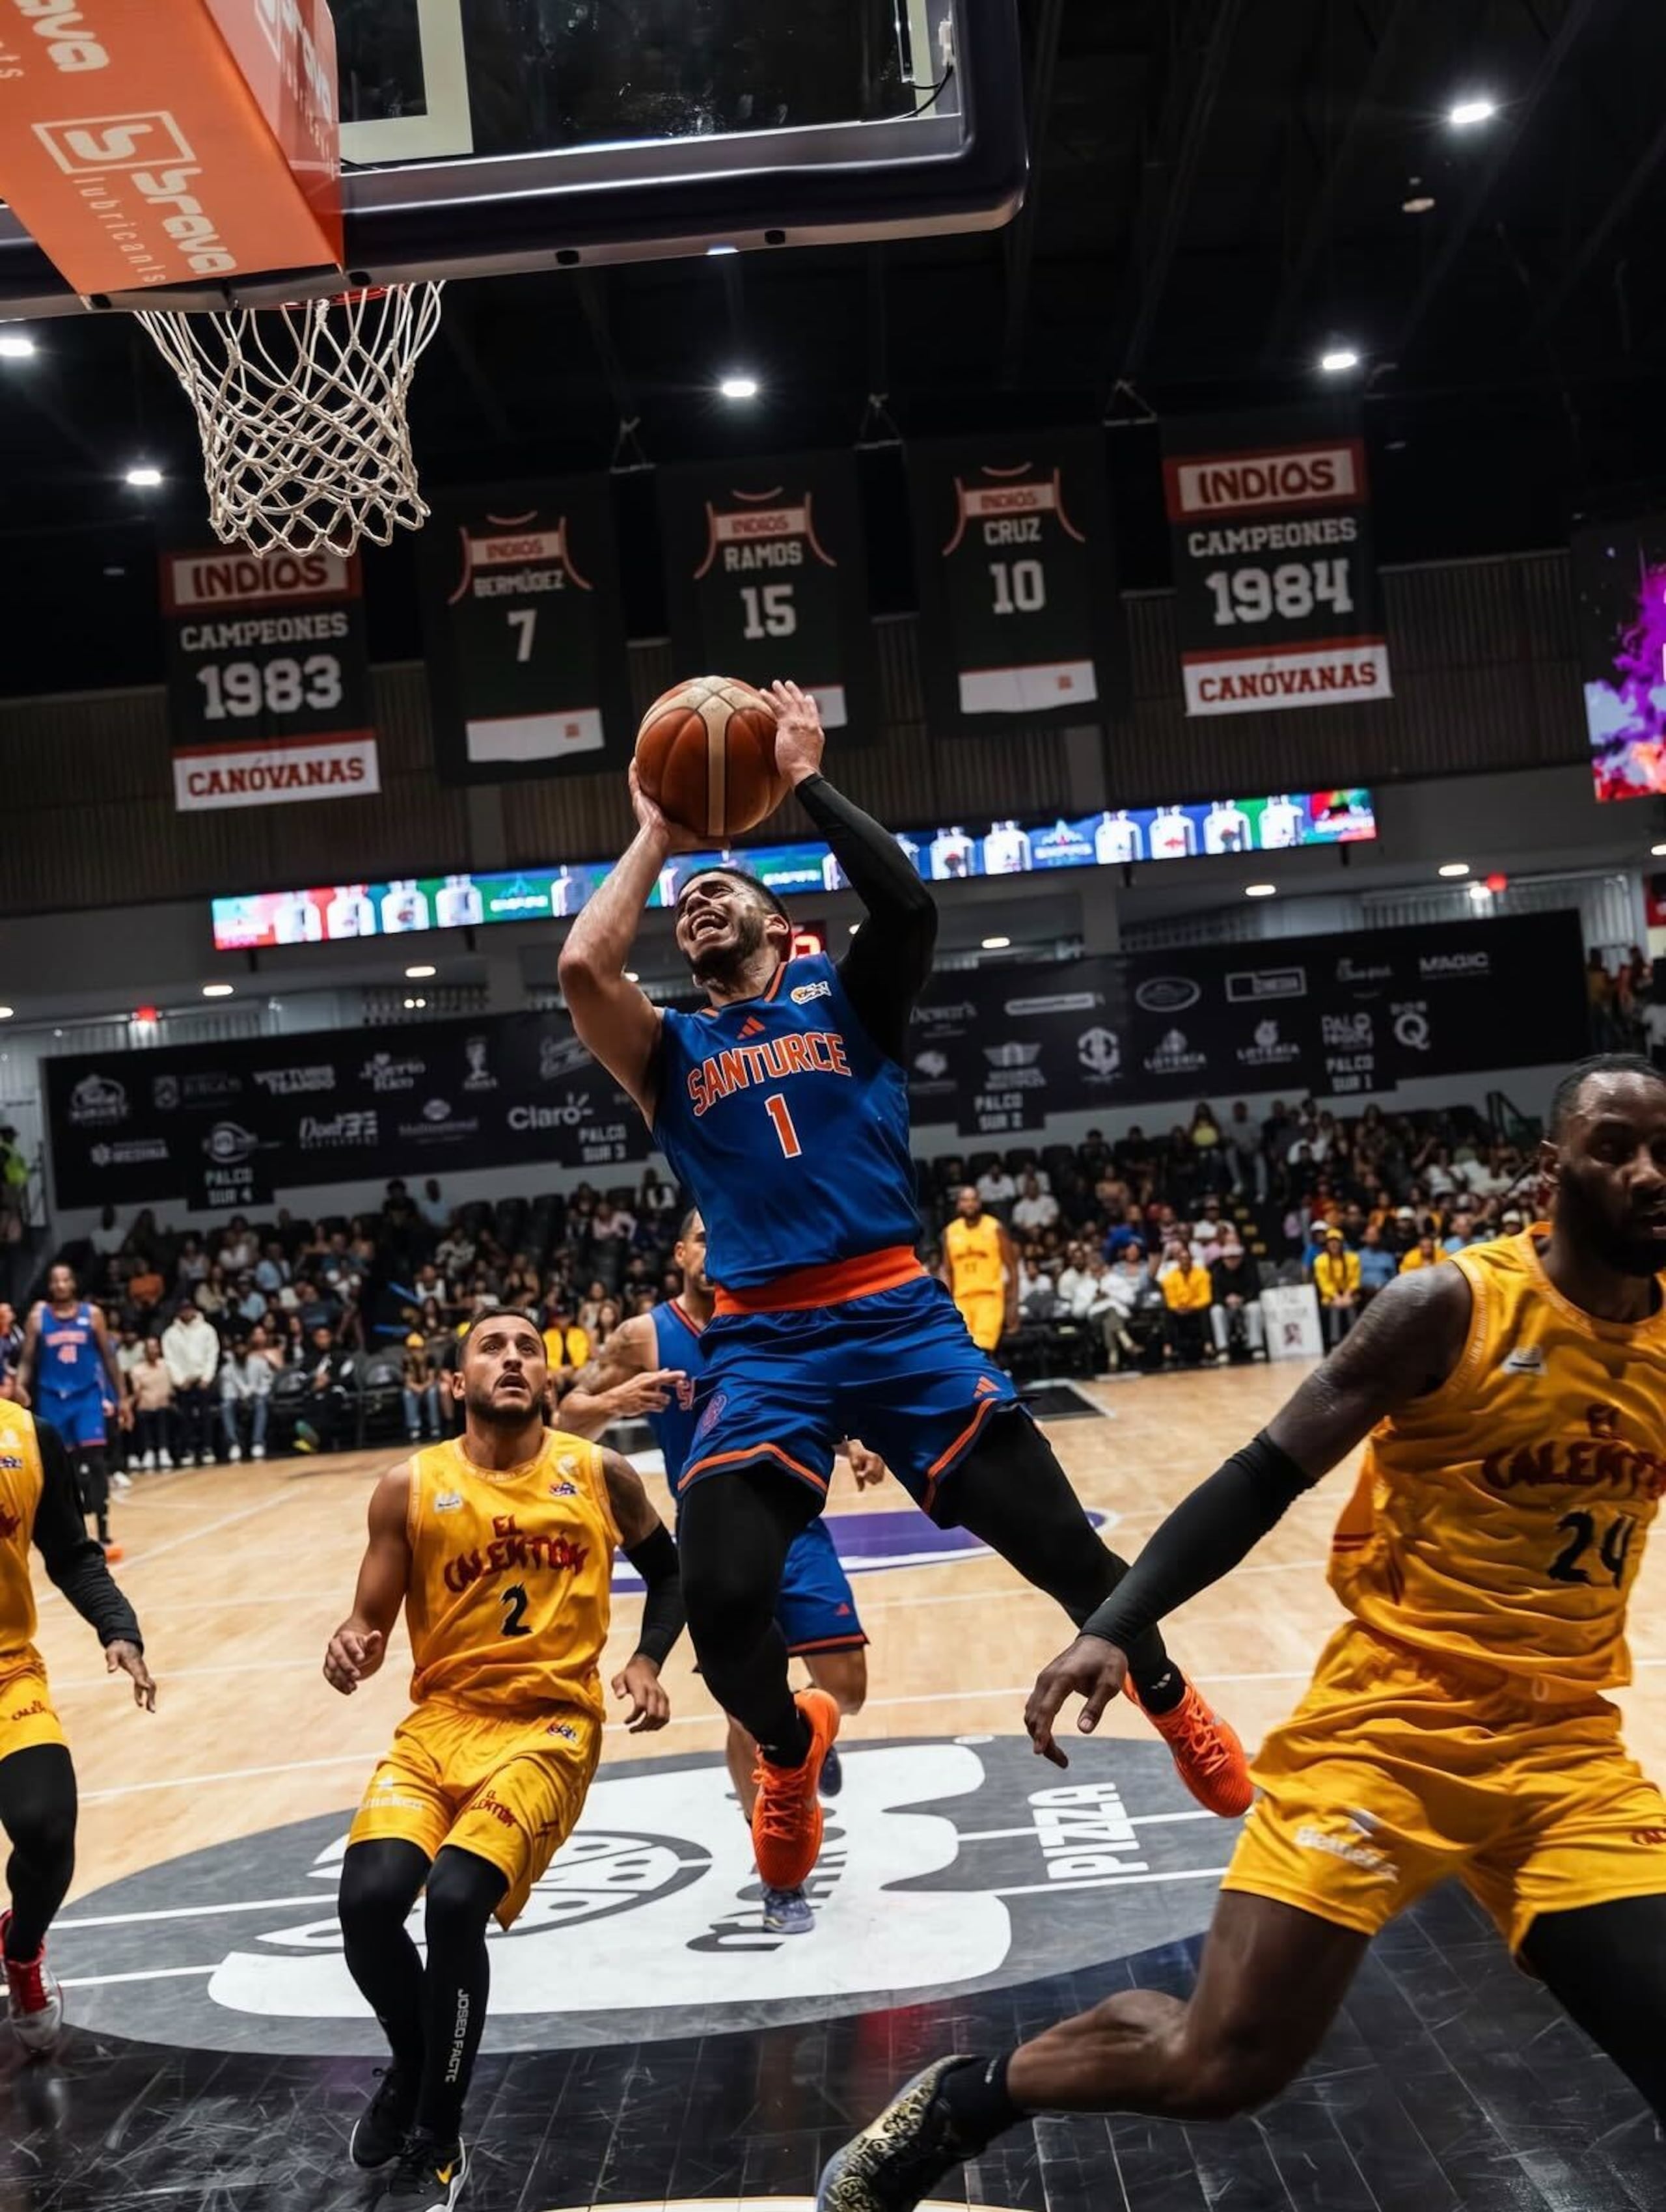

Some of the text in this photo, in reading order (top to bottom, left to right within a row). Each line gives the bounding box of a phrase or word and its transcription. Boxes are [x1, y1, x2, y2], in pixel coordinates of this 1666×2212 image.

[72, 176, 167, 284] lubricants
[1198, 459, 1335, 505] INDIOS
[723, 541, 804, 572] RAMOS
[984, 517, 1042, 545] CRUZ
[1188, 517, 1358, 557] CAMPEONES
[193, 554, 329, 598] INDIOS
[989, 560, 1047, 614] 10
[1205, 558, 1354, 626] 1984
[180, 612, 349, 651] CAMPEONES
[507, 608, 538, 662] 7
[740, 584, 797, 640] 15
[196, 655, 342, 720] 1983
[1394, 1012, 1432, 1051] Q
[686, 1031, 853, 1117] SANTURCE
[508, 1101, 583, 1130] Claro
[764, 1093, 803, 1160] 1
[492, 1514, 525, 1538] EL
[1547, 1510, 1638, 1590] 24
[499, 1581, 534, 1636] 2
[1027, 1782, 1149, 1879] PIZZA
